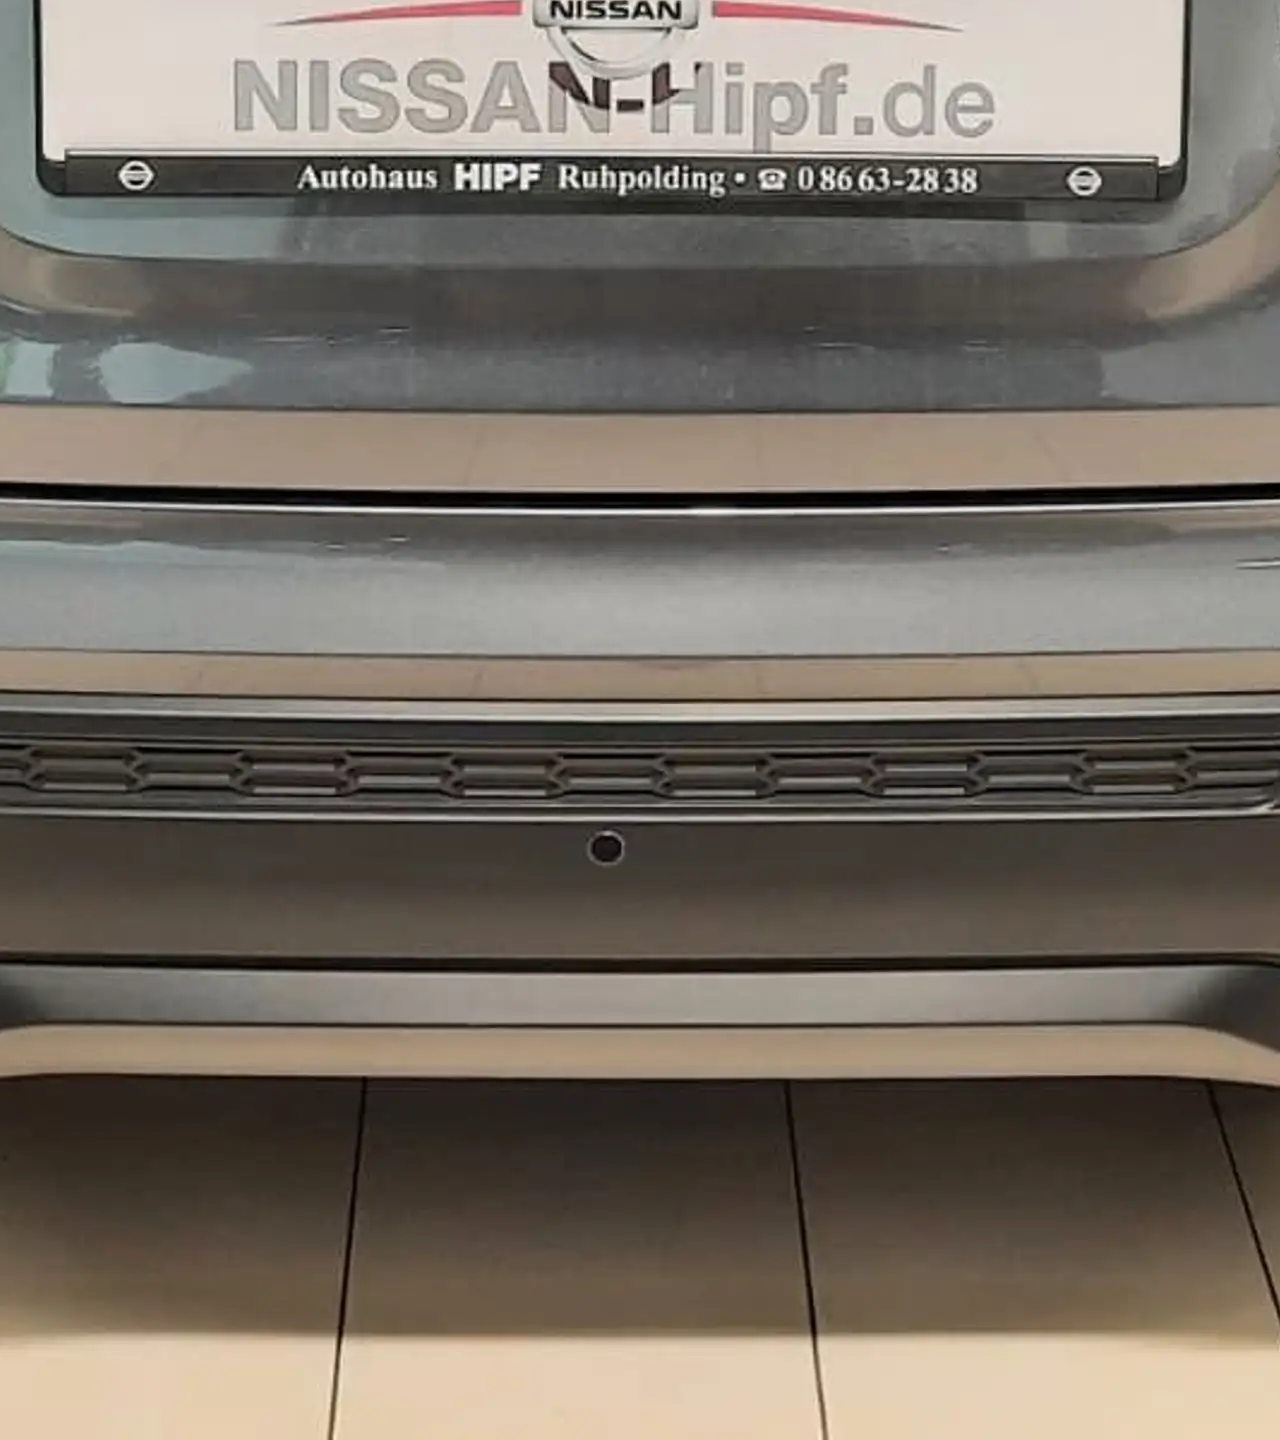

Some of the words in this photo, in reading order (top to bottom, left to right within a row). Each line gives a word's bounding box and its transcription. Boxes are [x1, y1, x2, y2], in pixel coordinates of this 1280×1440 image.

[549, 0, 682, 19] NISSAN
[233, 58, 996, 153] NISSAN-Hipf.de
[297, 163, 437, 190] Autohaus
[454, 162, 541, 191] HIPF
[558, 165, 726, 197] Ruhpolding
